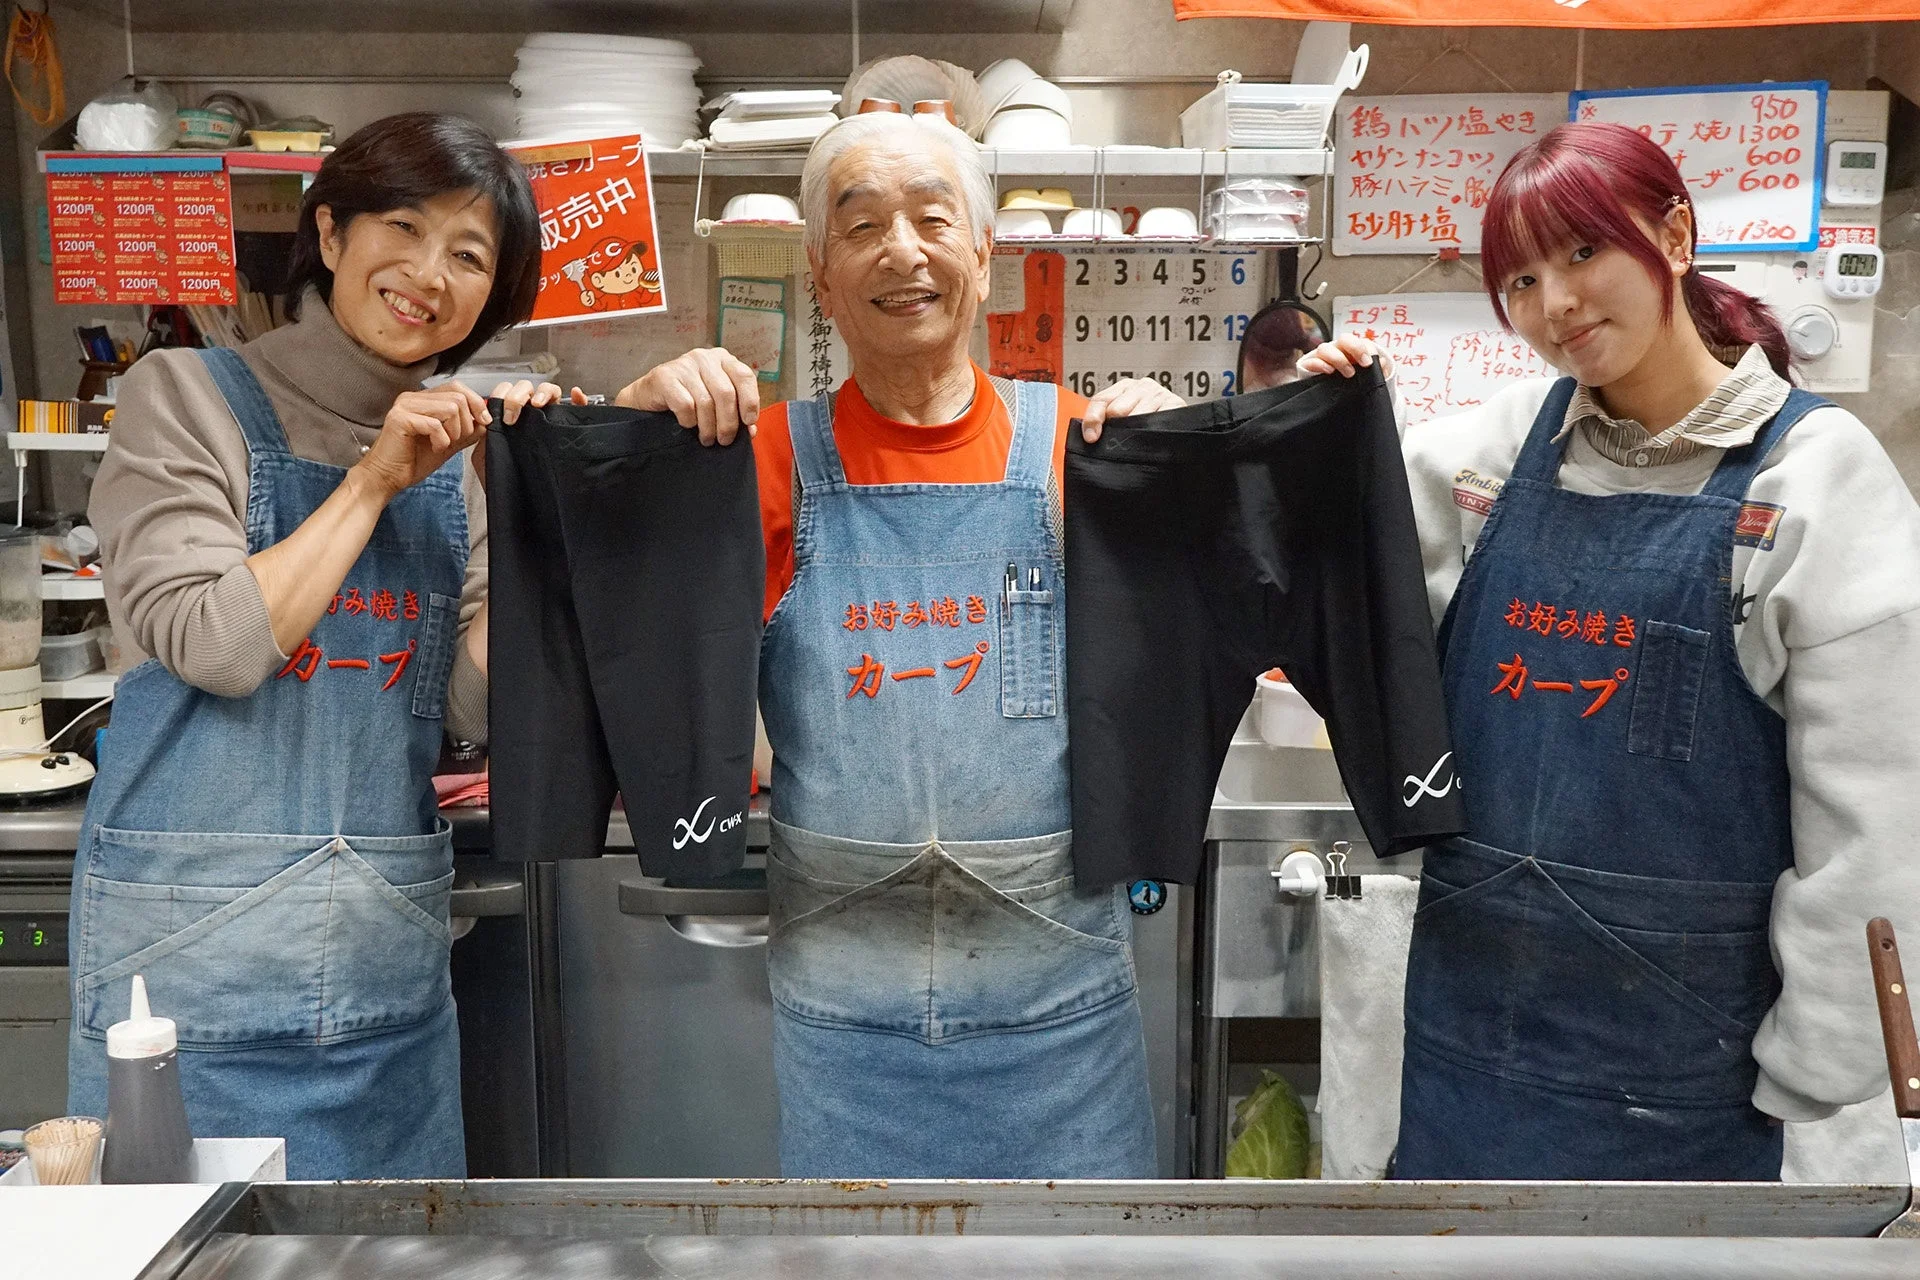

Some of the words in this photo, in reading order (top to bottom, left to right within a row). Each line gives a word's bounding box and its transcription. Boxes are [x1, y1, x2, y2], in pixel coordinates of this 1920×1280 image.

[1751, 94, 1798, 123] 950
[1738, 123, 1800, 144] 1300
[1746, 146, 1801, 167] 600
[1738, 169, 1800, 192] 600
[56, 203, 94, 215] 1200円
[116, 203, 155, 215] 1200円
[177, 204, 215, 216] 1200円
[1348, 205, 1462, 243] 砂肝塩
[1738, 219, 1797, 241] 1300
[57, 240, 95, 252] 1200円
[117, 241, 156, 252] 1200円
[178, 241, 218, 253] 1200円
[1039, 259, 1049, 286] 1
[1075, 259, 1090, 286] 2
[1114, 259, 1128, 286] 3
[1153, 259, 1168, 285] 4
[1192, 259, 1206, 285] 5
[1231, 258, 1245, 285] 6
[60, 277, 96, 289] 1200円
[119, 278, 158, 290] 1200円
[180, 278, 220, 290] 1200円
[1345, 304, 1414, 325] エダ豆
[997, 314, 1016, 344] 7
[1036, 313, 1053, 343] 8
[1075, 315, 1090, 342] 9
[1107, 315, 1134, 342] 10
[1146, 315, 1170, 341] 11
[1184, 315, 1211, 341] 12
[1223, 314, 1249, 341] 13
[1068, 371, 1096, 398] 16
[1184, 371, 1210, 397] 19
[1221, 370, 1235, 397] 2
[842, 594, 987, 632] お好み焼き
[1504, 597, 1637, 648] お好み焼き
[275, 637, 417, 691] カープ
[846, 640, 990, 699] カープ
[1490, 653, 1630, 719] カープ
[34, 930, 43, 946] 3
